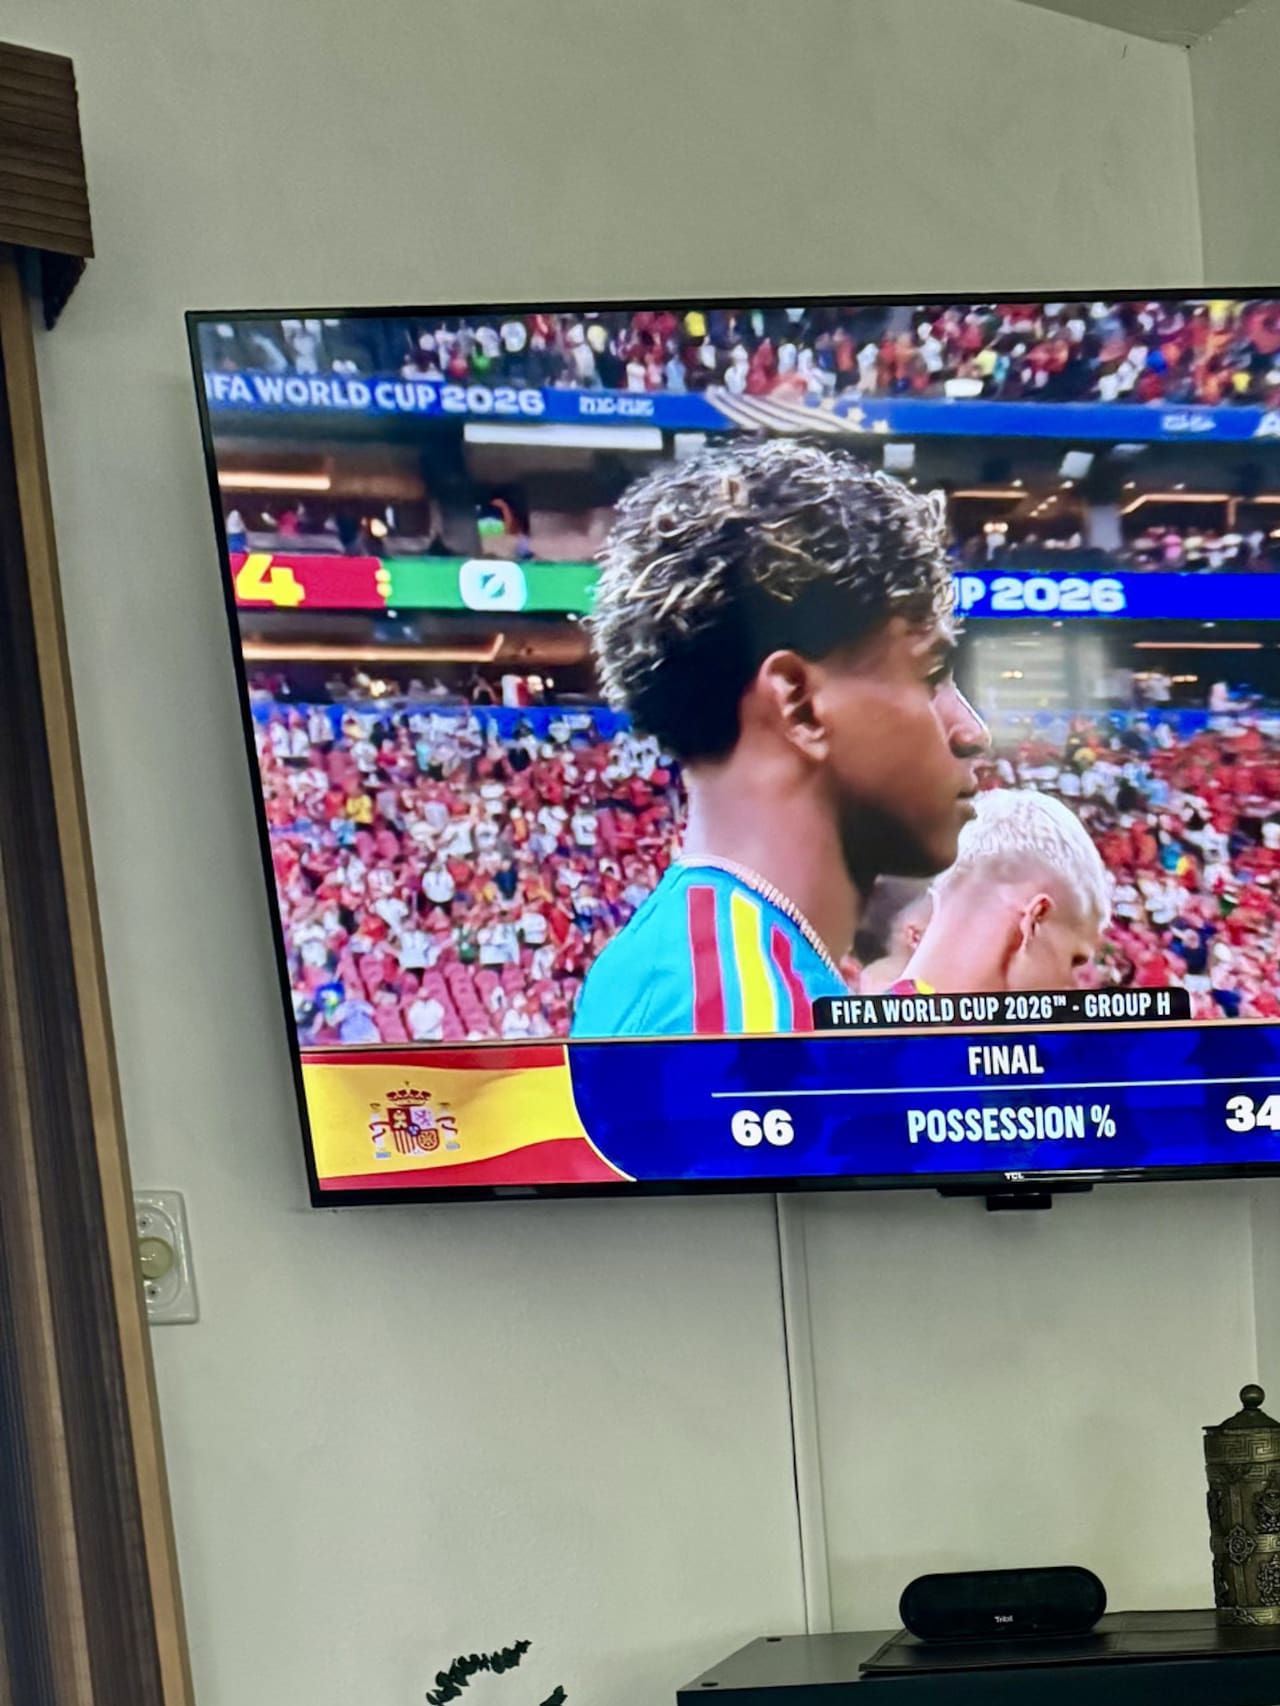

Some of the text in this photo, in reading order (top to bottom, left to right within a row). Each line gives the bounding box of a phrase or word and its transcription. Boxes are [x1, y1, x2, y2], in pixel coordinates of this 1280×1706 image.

[253, 376, 371, 408] WORLD
[375, 383, 436, 411] CUP
[440, 385, 545, 415] 2026
[990, 577, 1126, 612] 2026
[831, 1000, 877, 1025] FIFA
[882, 998, 954, 1023] WORLD
[959, 996, 1000, 1021] CUP
[1085, 993, 1151, 1018] GROUP
[1157, 992, 1171, 1016] H
[968, 1044, 1045, 1076] FINAL
[730, 1109, 794, 1147] 66
[907, 1104, 1117, 1144] POSSESSION %
